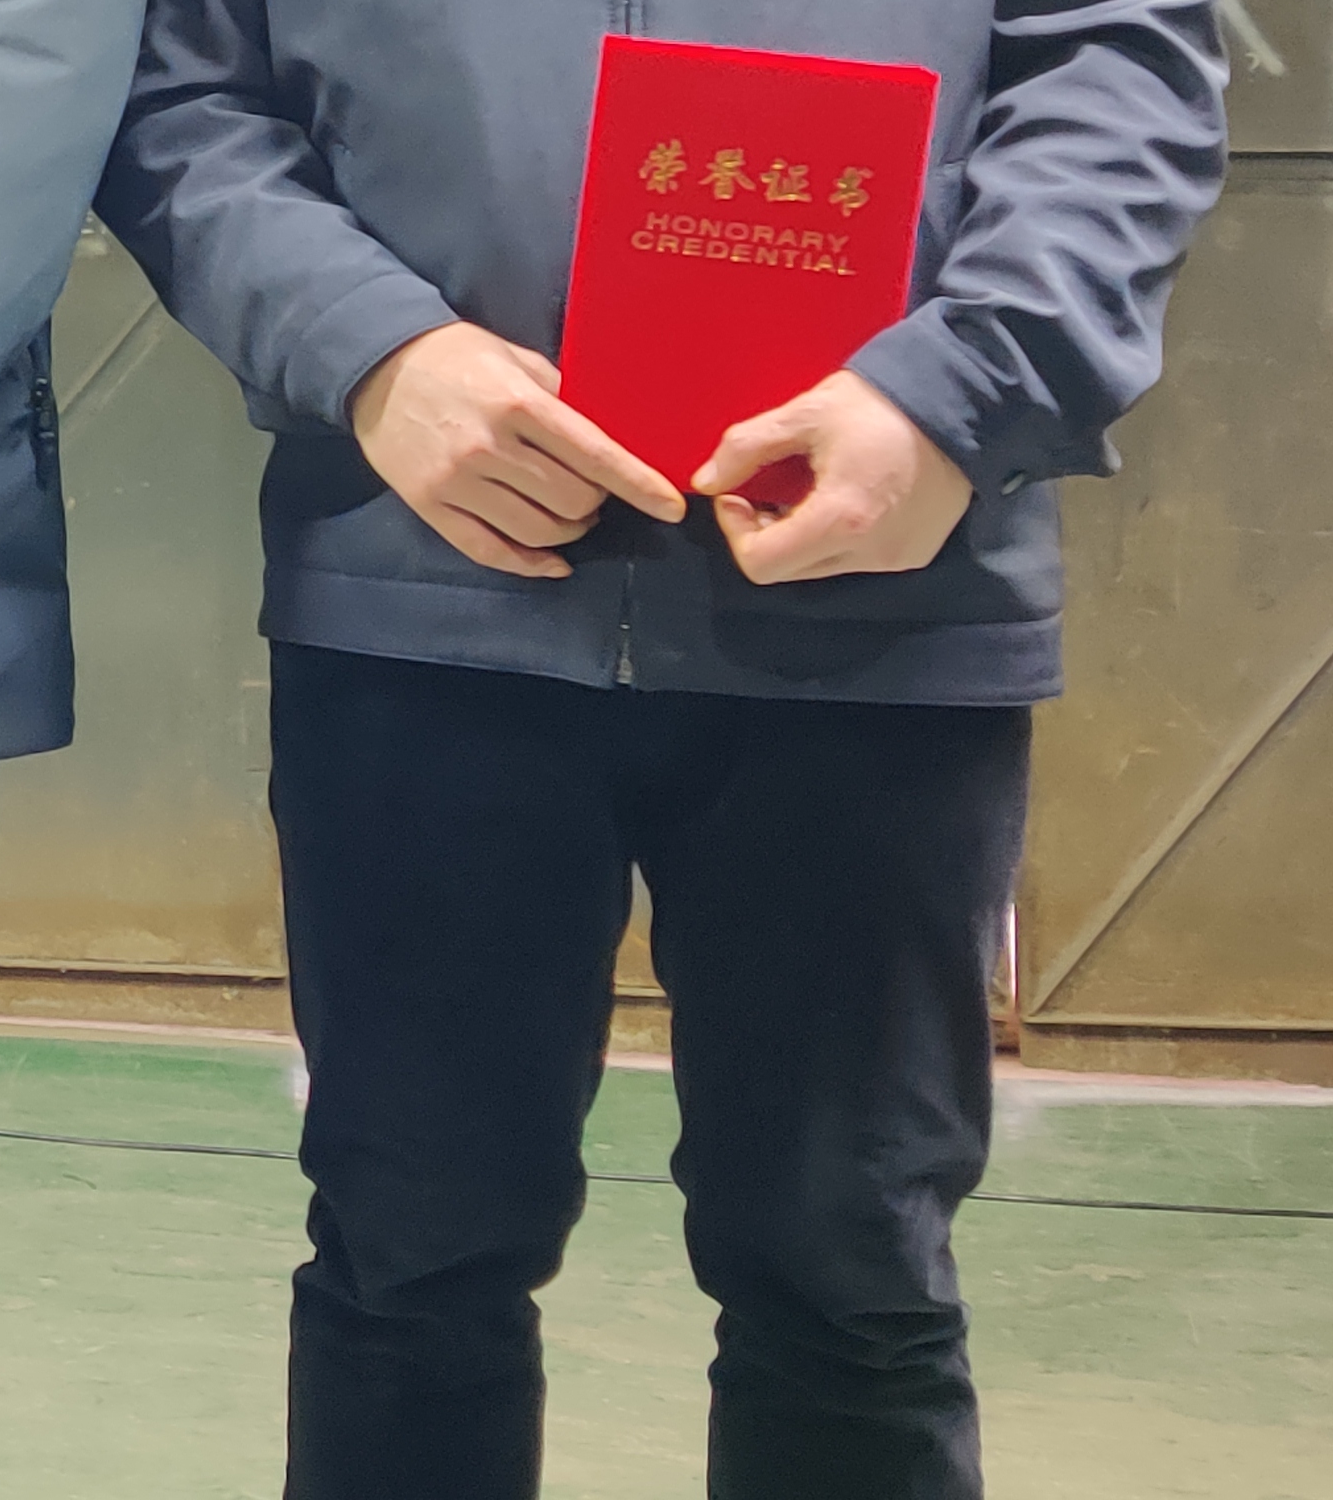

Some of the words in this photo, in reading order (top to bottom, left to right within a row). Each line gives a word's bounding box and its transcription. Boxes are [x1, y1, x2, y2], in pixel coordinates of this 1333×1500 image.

[639, 138, 874, 217] 荣誉证书
[631, 230, 858, 276] CREDENTIAL
[645, 211, 850, 254] HONORARY
